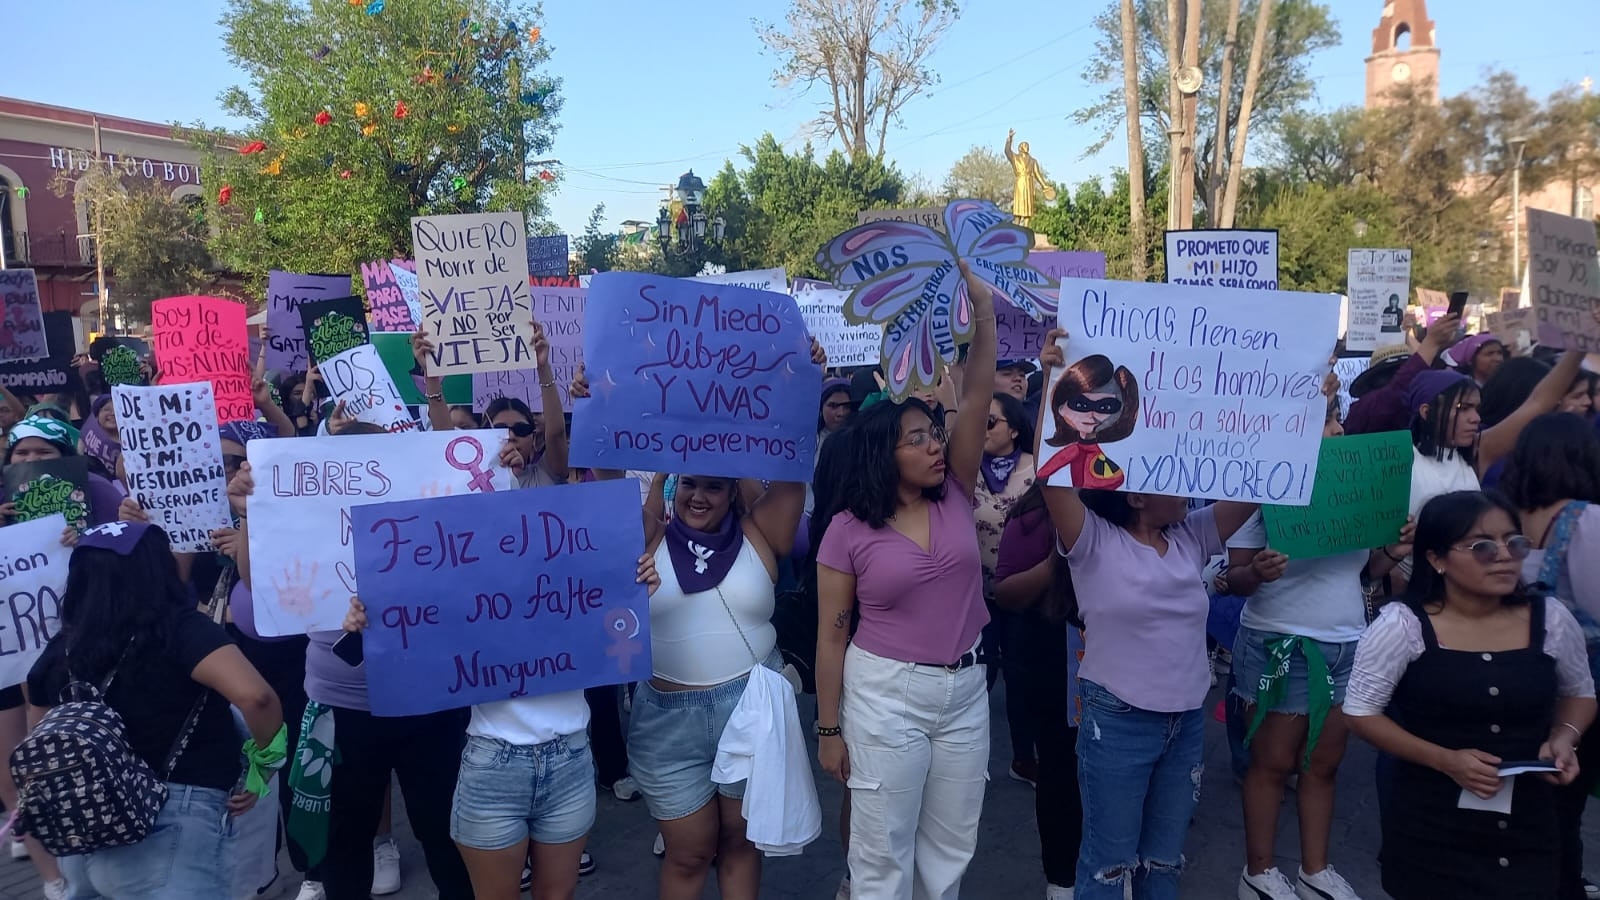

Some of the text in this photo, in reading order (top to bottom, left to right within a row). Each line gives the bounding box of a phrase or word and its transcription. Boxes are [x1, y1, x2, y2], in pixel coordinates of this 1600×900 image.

[50, 147, 153, 179] HIDLGO
[414, 219, 517, 253] QUIERO
[967, 210, 1004, 234] NOS
[484, 252, 510, 273] de
[852, 245, 909, 281] NOS
[1177, 238, 1270, 257] PROMETO QUE
[1193, 259, 1258, 277] MI HIJO
[154, 303, 219, 328] Soy la
[428, 284, 515, 315] VIEJA
[636, 285, 781, 335] Sin Miedo
[886, 260, 953, 344] SEMBRARON
[196, 324, 222, 348] de
[452, 313, 477, 332] NO
[932, 292, 952, 357] MIEDO
[1190, 306, 1280, 351] Piensen
[269, 335, 305, 353] GAT
[428, 336, 531, 368] VIEJA
[634, 328, 797, 380] libres
[322, 350, 376, 398] LOS
[1214, 351, 1320, 400] hombres
[120, 393, 145, 421] DE
[653, 373, 772, 420] Y VIVAS
[1188, 408, 1203, 431] a
[1217, 398, 1280, 437] salvar
[1285, 406, 1308, 438] al
[140, 452, 152, 469] Y
[614, 430, 797, 462] nos queremos
[272, 460, 392, 497] LIBRES
[14, 480, 74, 513] Aborto
[163, 510, 183, 524] EL
[382, 573, 604, 650] que no falte
[448, 650, 576, 698] Ninguna
